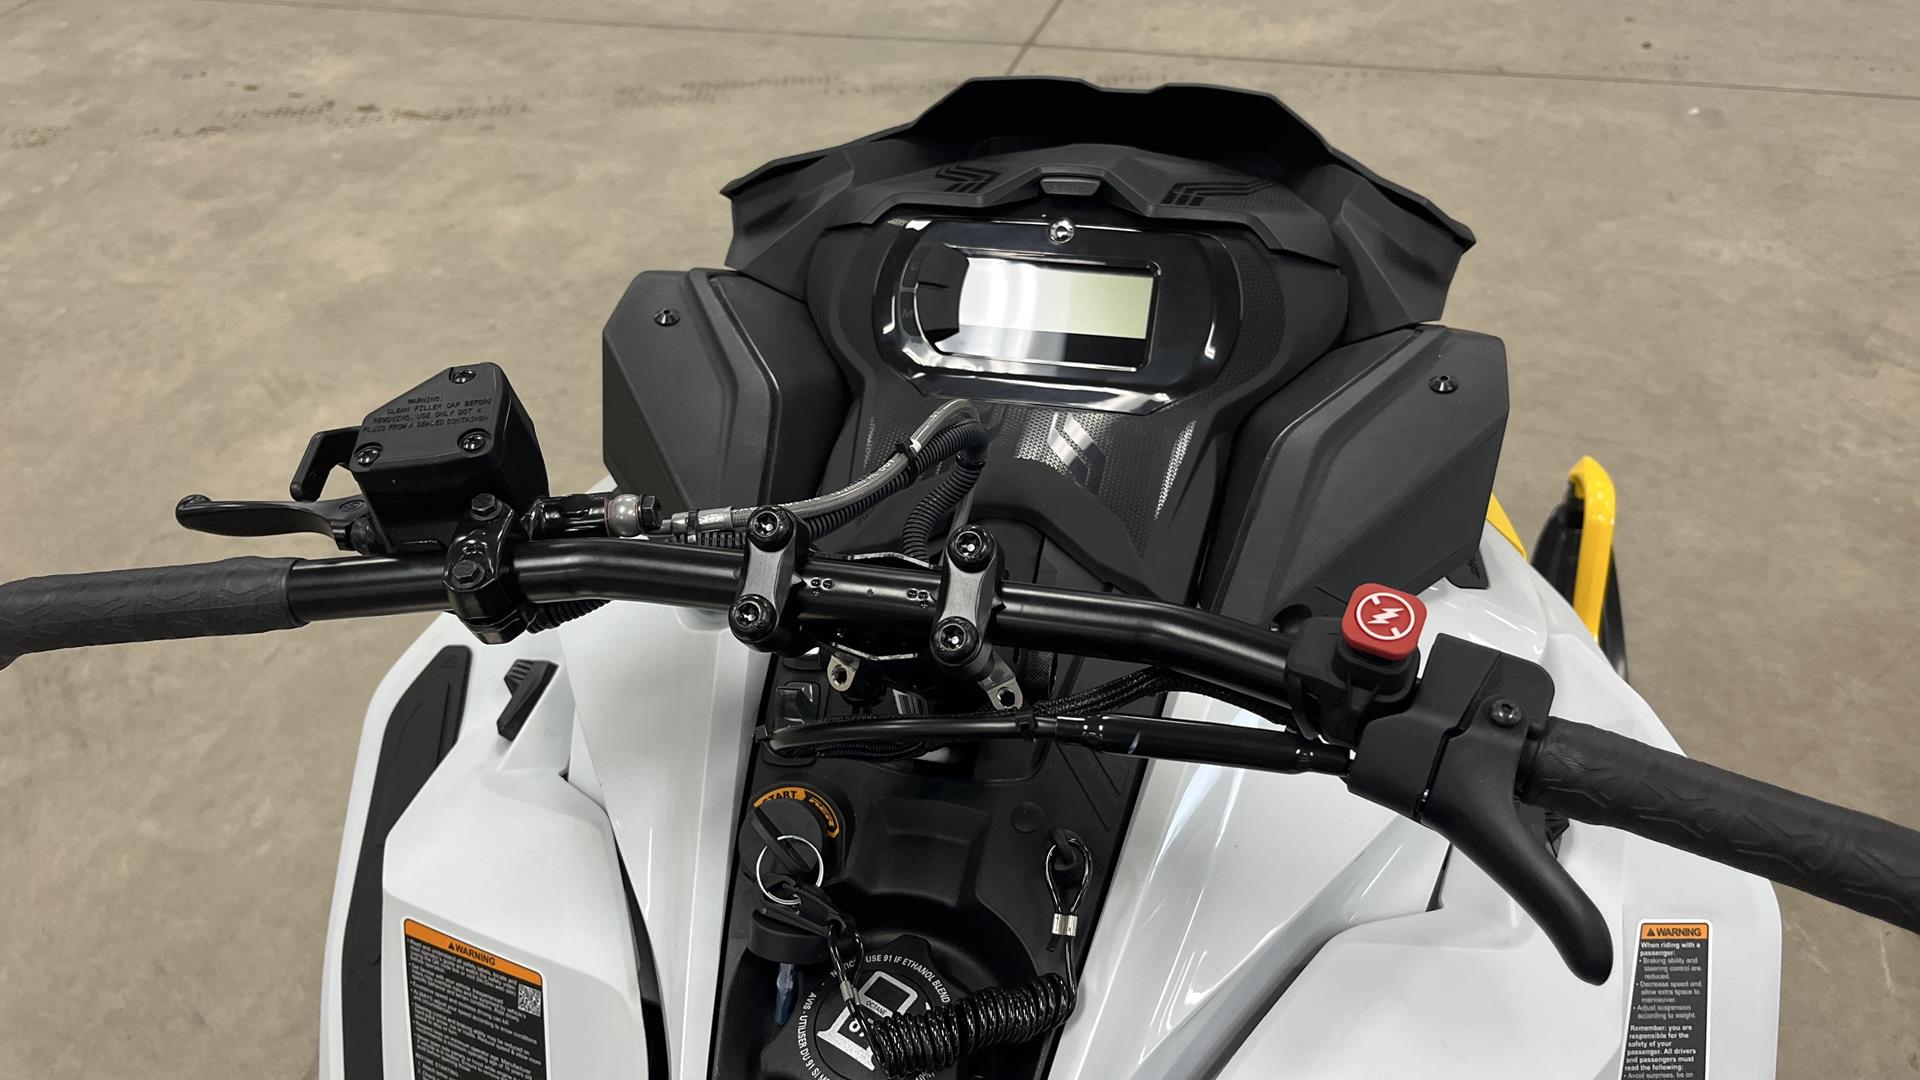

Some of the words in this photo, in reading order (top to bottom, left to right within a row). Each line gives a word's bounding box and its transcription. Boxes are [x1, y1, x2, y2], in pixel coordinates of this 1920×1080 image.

[416, 412, 430, 420] USE
[458, 408, 473, 416] DOT
[417, 420, 445, 429] SEALED
[1656, 928, 1702, 937] WARNING
[1660, 942, 1680, 950] riding
[455, 943, 496, 966] WARNING
[1643, 957, 1666, 965] Braking
[1667, 957, 1685, 965] ability
[865, 954, 882, 963] USE
[883, 954, 892, 963] 91
[893, 955, 902, 966] IF
[902, 958, 936, 983] ETHANOL
[931, 980, 951, 1004] BLEND
[802, 991, 817, 1010] AVIS
[865, 1000, 888, 1016] OCTANE
[797, 1014, 809, 1048] UTILISER
[1628, 1040, 1647, 1048] safety
[799, 1046, 811, 1062] DU
[805, 1059, 816, 1071] 91
[811, 1067, 820, 1079] SI
